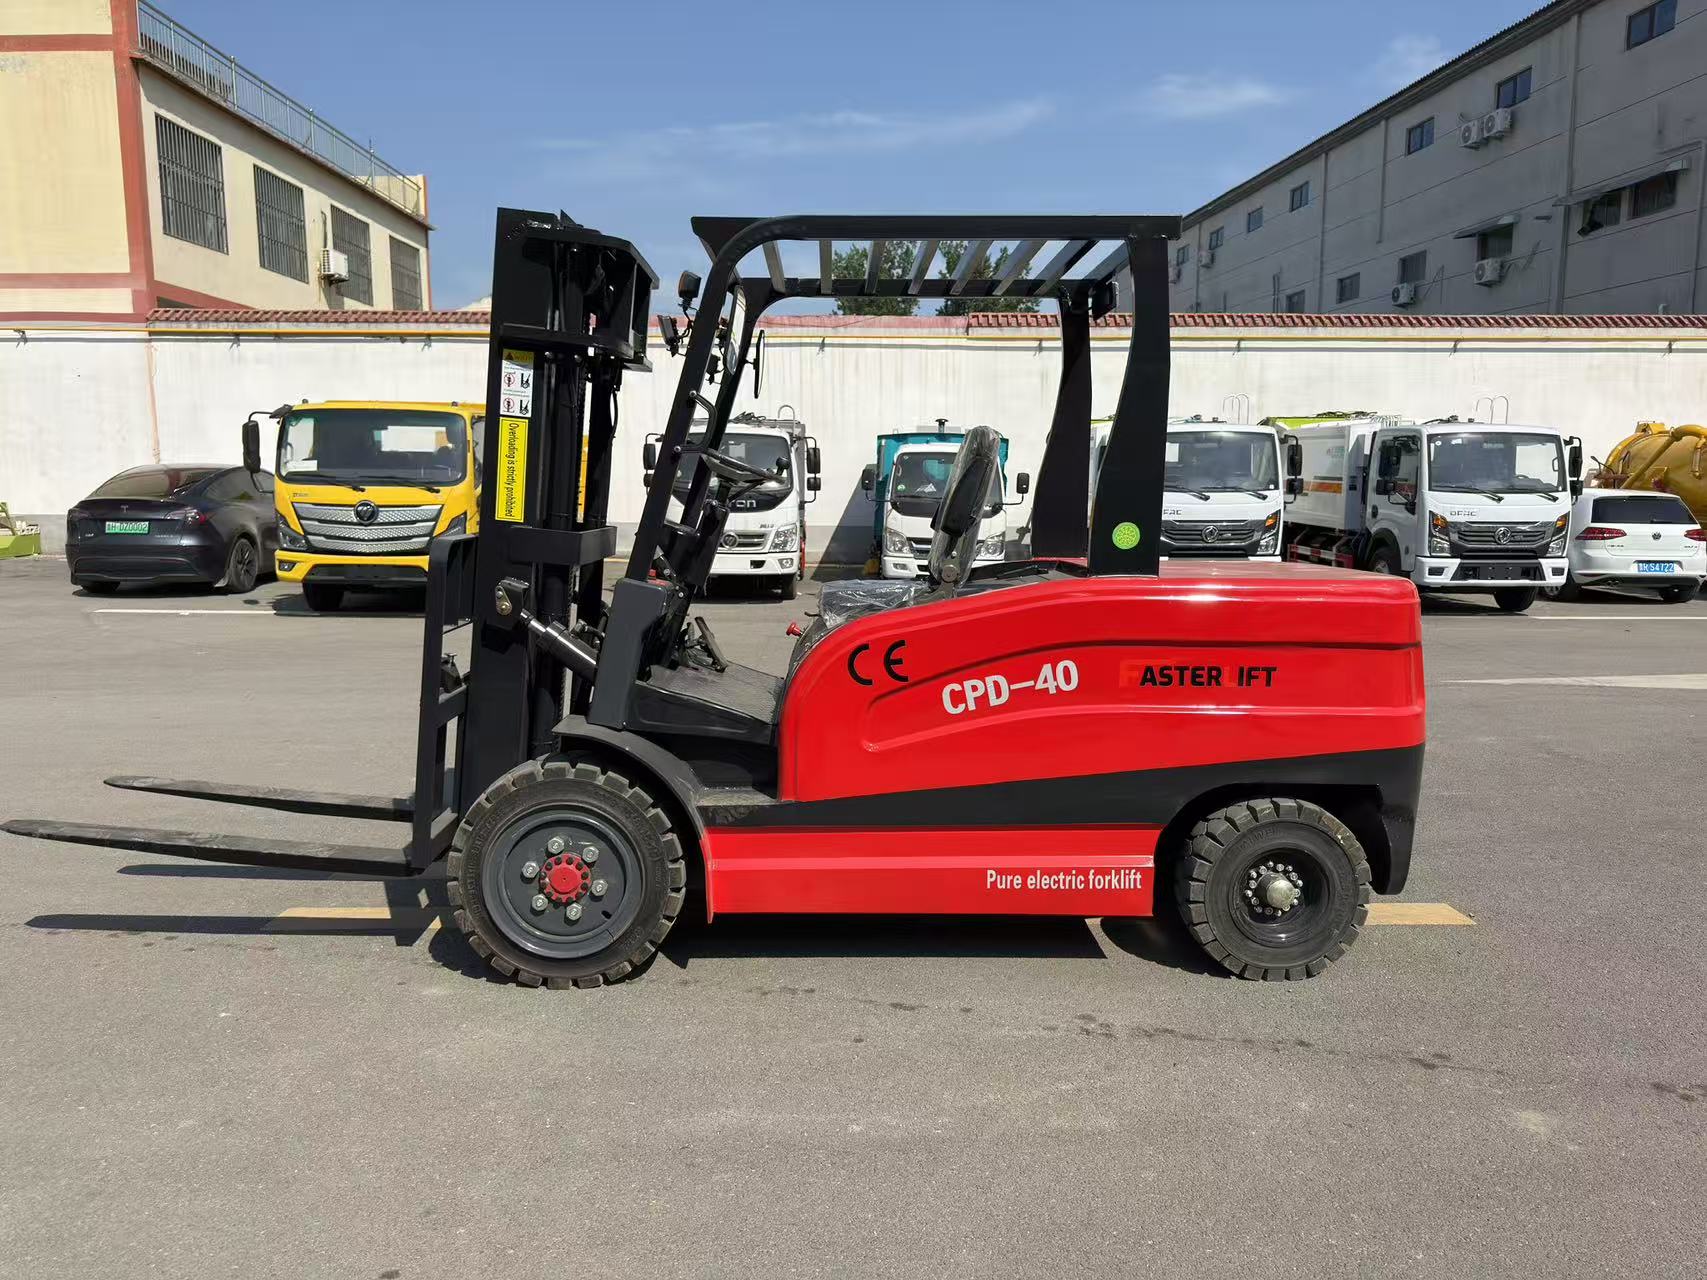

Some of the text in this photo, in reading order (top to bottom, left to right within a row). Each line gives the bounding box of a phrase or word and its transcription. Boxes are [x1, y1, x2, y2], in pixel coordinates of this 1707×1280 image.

[505, 422, 519, 459] Overloading
[504, 466, 516, 487] strictly
[504, 487, 516, 517] prohibited
[847, 640, 909, 686] CE
[986, 868, 1142, 889] Pure electric forklift
